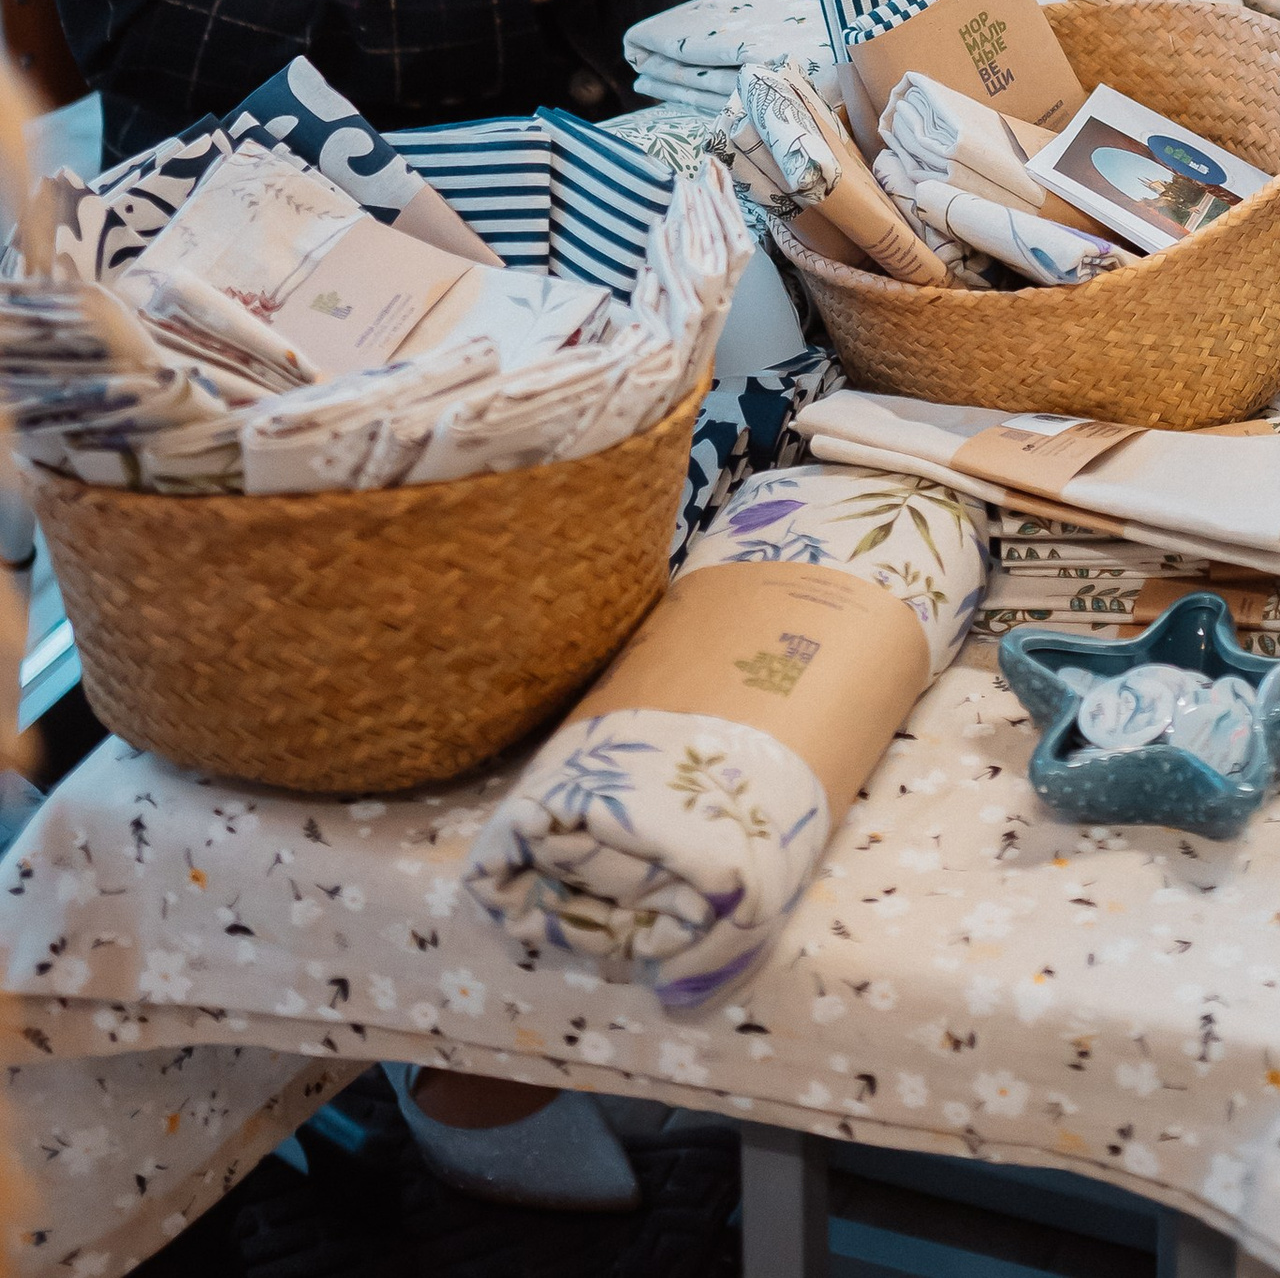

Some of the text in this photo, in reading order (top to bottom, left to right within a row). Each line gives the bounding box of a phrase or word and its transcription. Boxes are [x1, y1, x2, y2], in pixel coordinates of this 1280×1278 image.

[958, 11, 989, 41] НОР
[964, 20, 1007, 56] МАЛЬ
[971, 36, 1008, 70] НЫЕ
[978, 60, 1001, 83] ВЕ
[984, 68, 1015, 97] ЩИ
